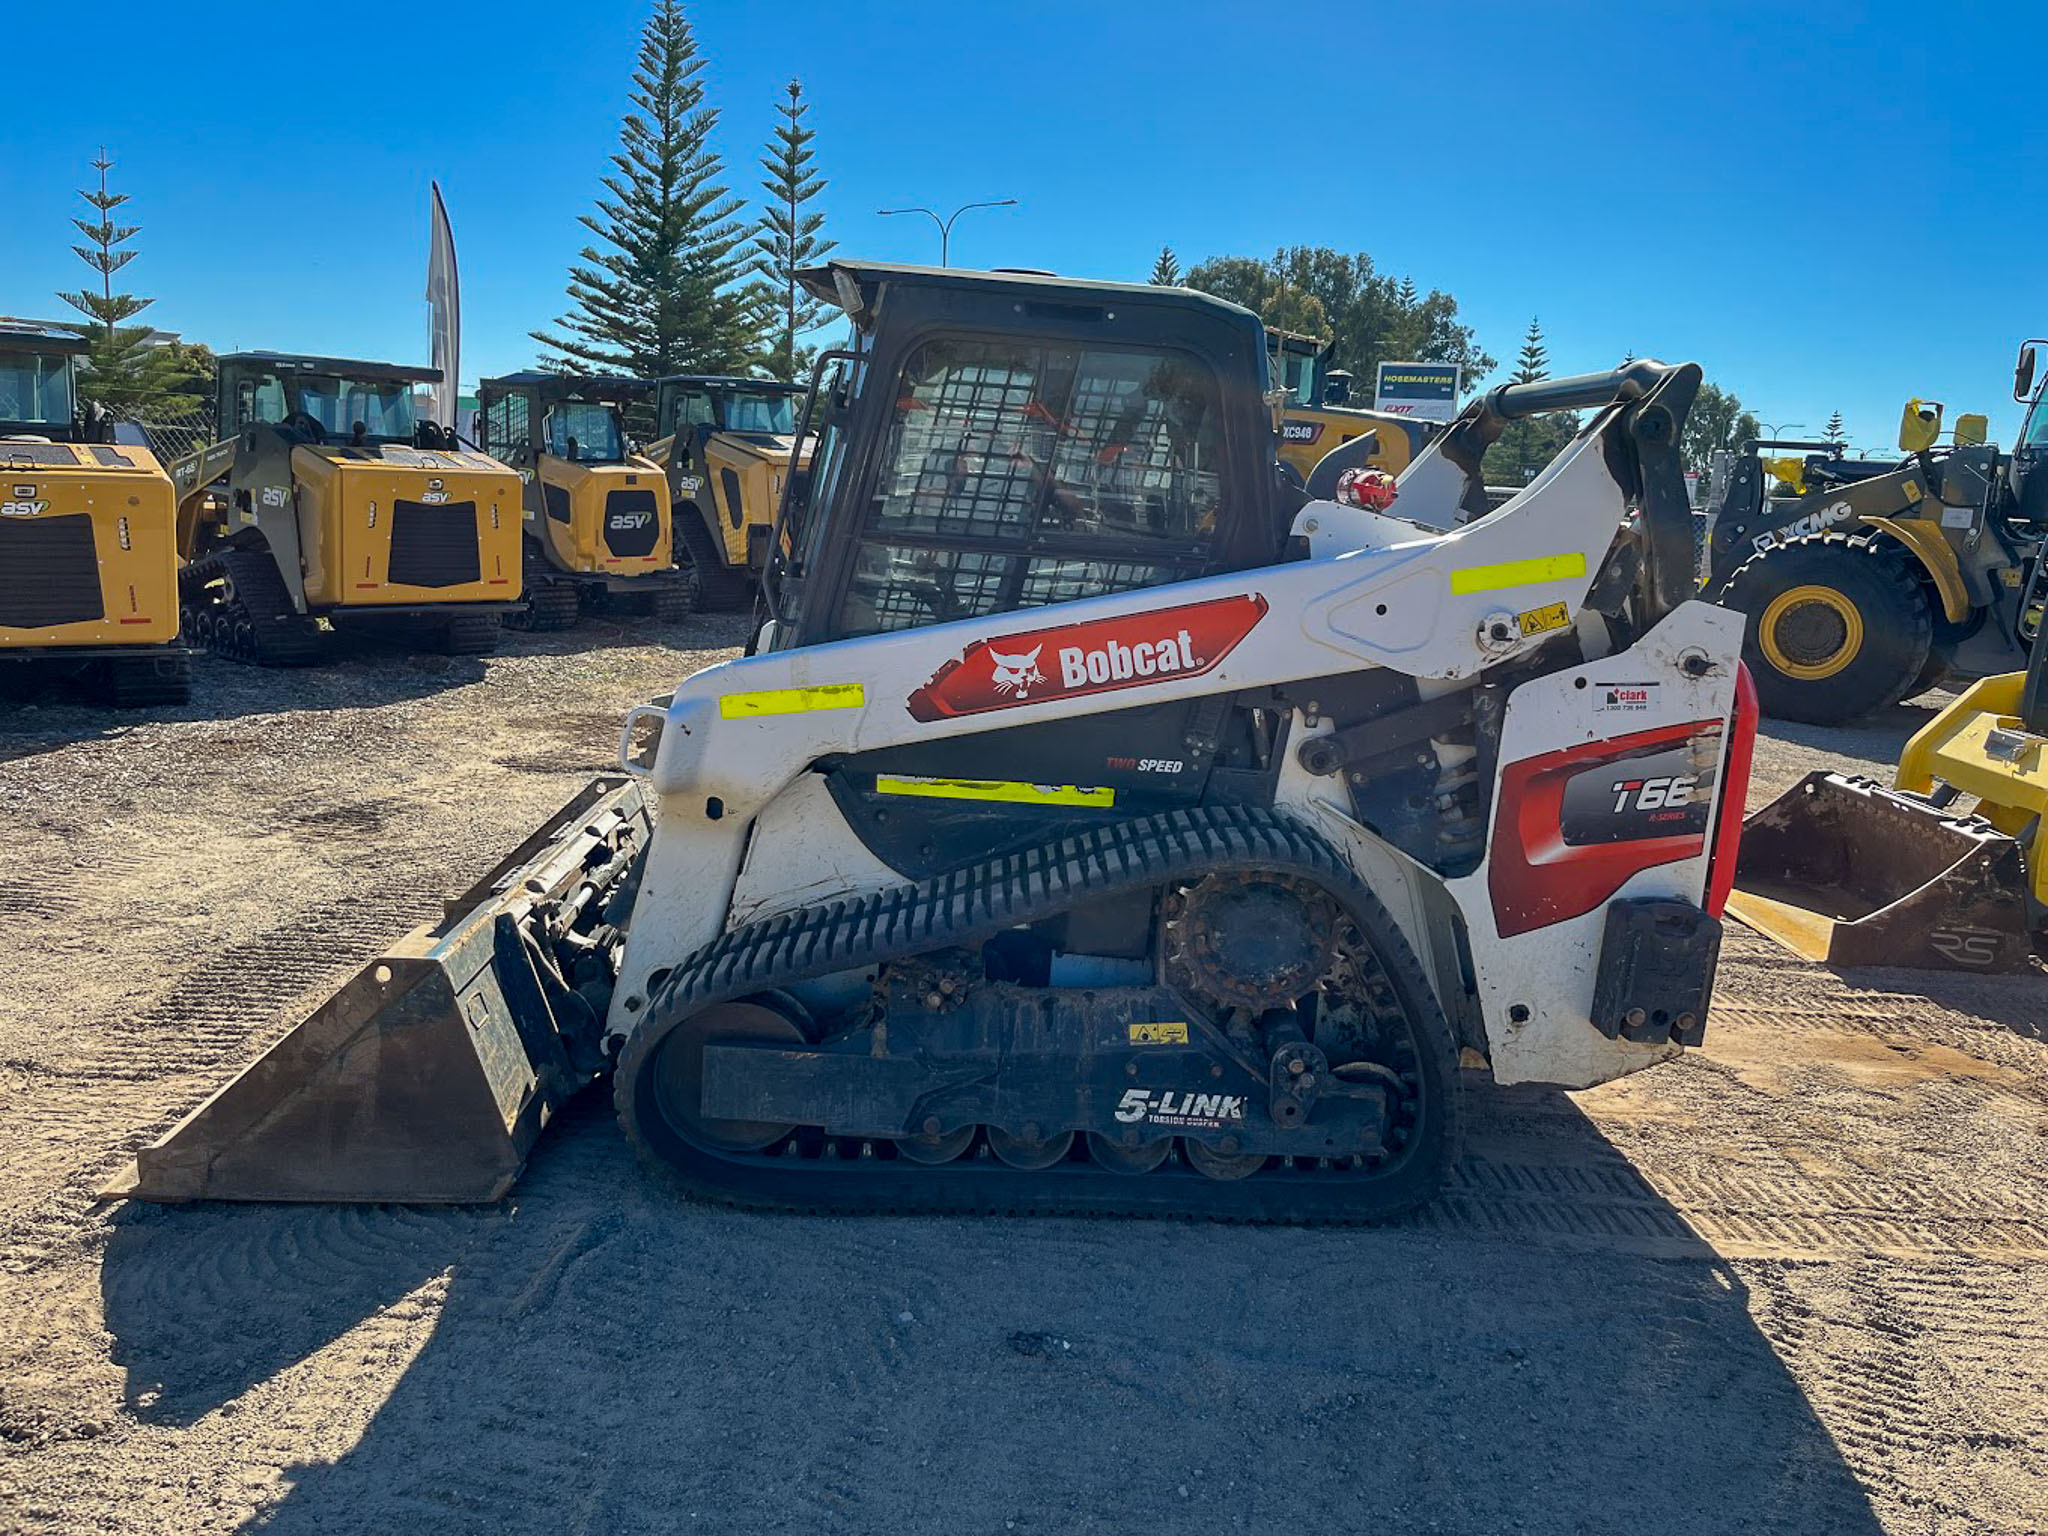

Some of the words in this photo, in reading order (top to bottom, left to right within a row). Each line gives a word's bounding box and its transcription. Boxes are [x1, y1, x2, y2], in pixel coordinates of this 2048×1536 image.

[1384, 375, 1453, 384] HOSEMASTERS
[1282, 426, 1312, 439] XC948
[1777, 501, 1852, 538] XCMG
[1058, 629, 1196, 689] Bobcat
[1620, 690, 1647, 700] clark
[1106, 757, 1136, 770] TWO
[1137, 759, 1184, 774] SPEED
[1114, 1088, 1243, 1123] 5-LINK
